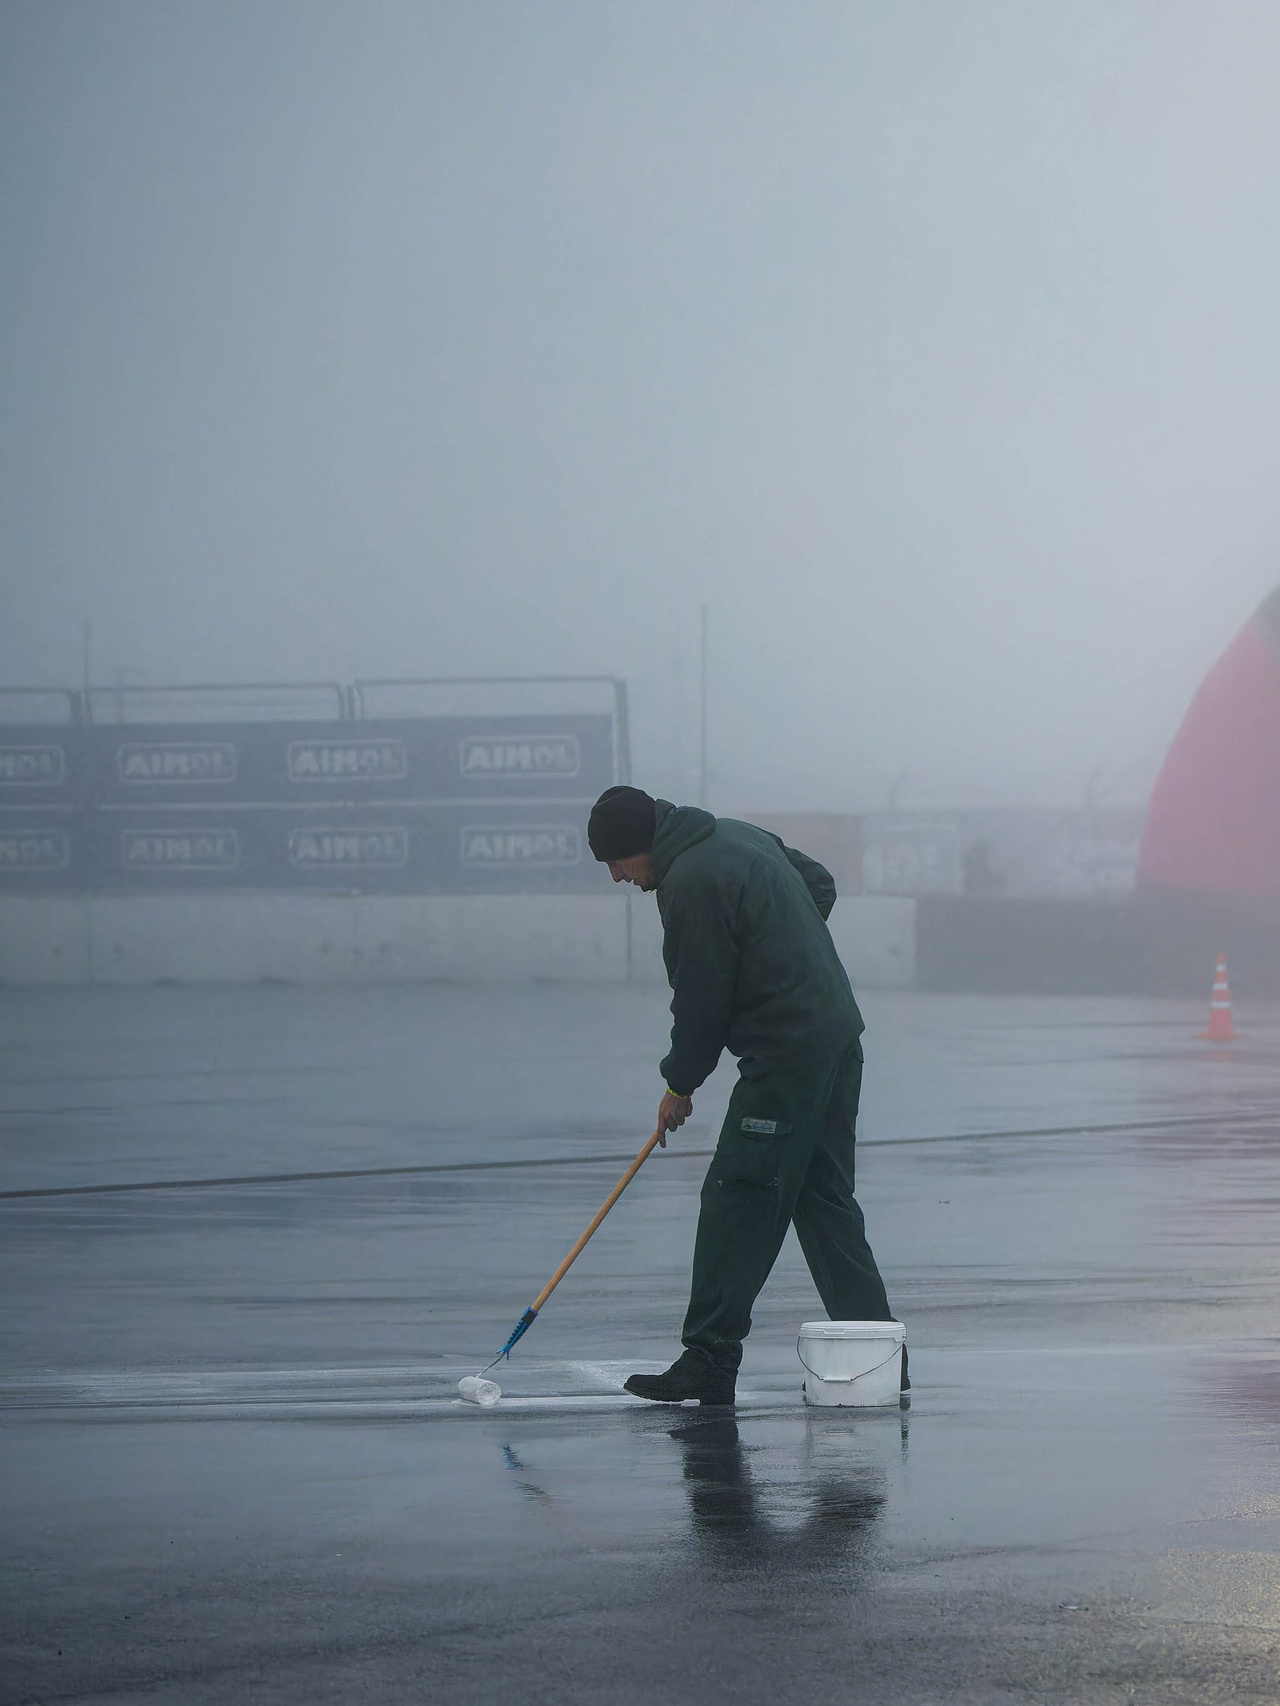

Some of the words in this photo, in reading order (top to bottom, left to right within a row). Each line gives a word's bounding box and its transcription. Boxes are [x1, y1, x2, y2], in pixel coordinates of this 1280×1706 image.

[122, 751, 227, 776] AIMOL
[294, 747, 399, 773] AIMOL
[466, 745, 572, 770] AIMOL
[128, 837, 229, 861] AIMOL
[296, 834, 401, 860] AIMOL
[467, 832, 573, 858] AIMOL
